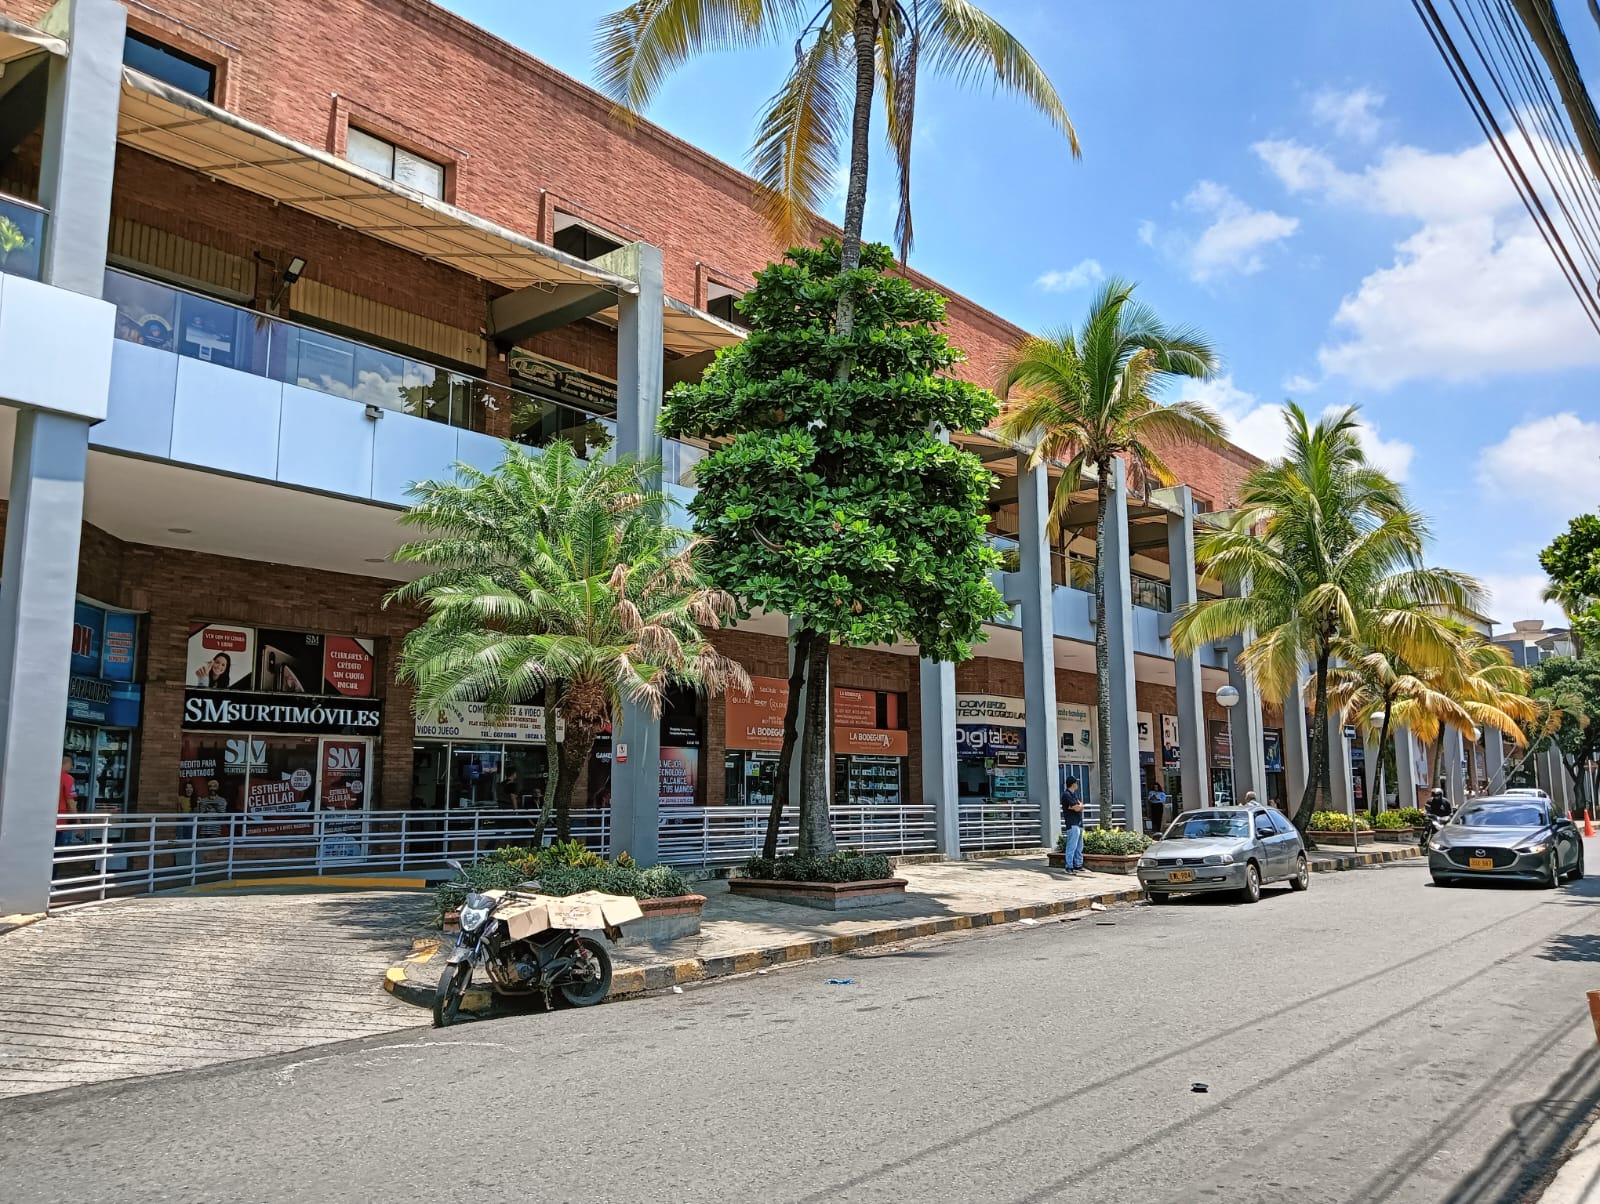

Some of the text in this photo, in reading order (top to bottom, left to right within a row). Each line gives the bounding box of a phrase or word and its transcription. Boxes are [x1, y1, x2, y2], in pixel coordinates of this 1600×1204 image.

[306, 634, 319, 643] SM
[330, 651, 369, 662] CELULARES A
[333, 671, 344, 679] SIN
[524, 708, 541, 718] VIDEO
[417, 726, 460, 736] VIDEO JUEGO
[746, 727, 785, 737] LA BODEGU
[849, 732, 857, 740] LA
[202, 759, 217, 768] PARA
[663, 777, 687, 785] ALCANCE
[251, 782, 290, 795] ESTRENA
[663, 785, 673, 793] TUS
[248, 791, 295, 807] CELULAR
